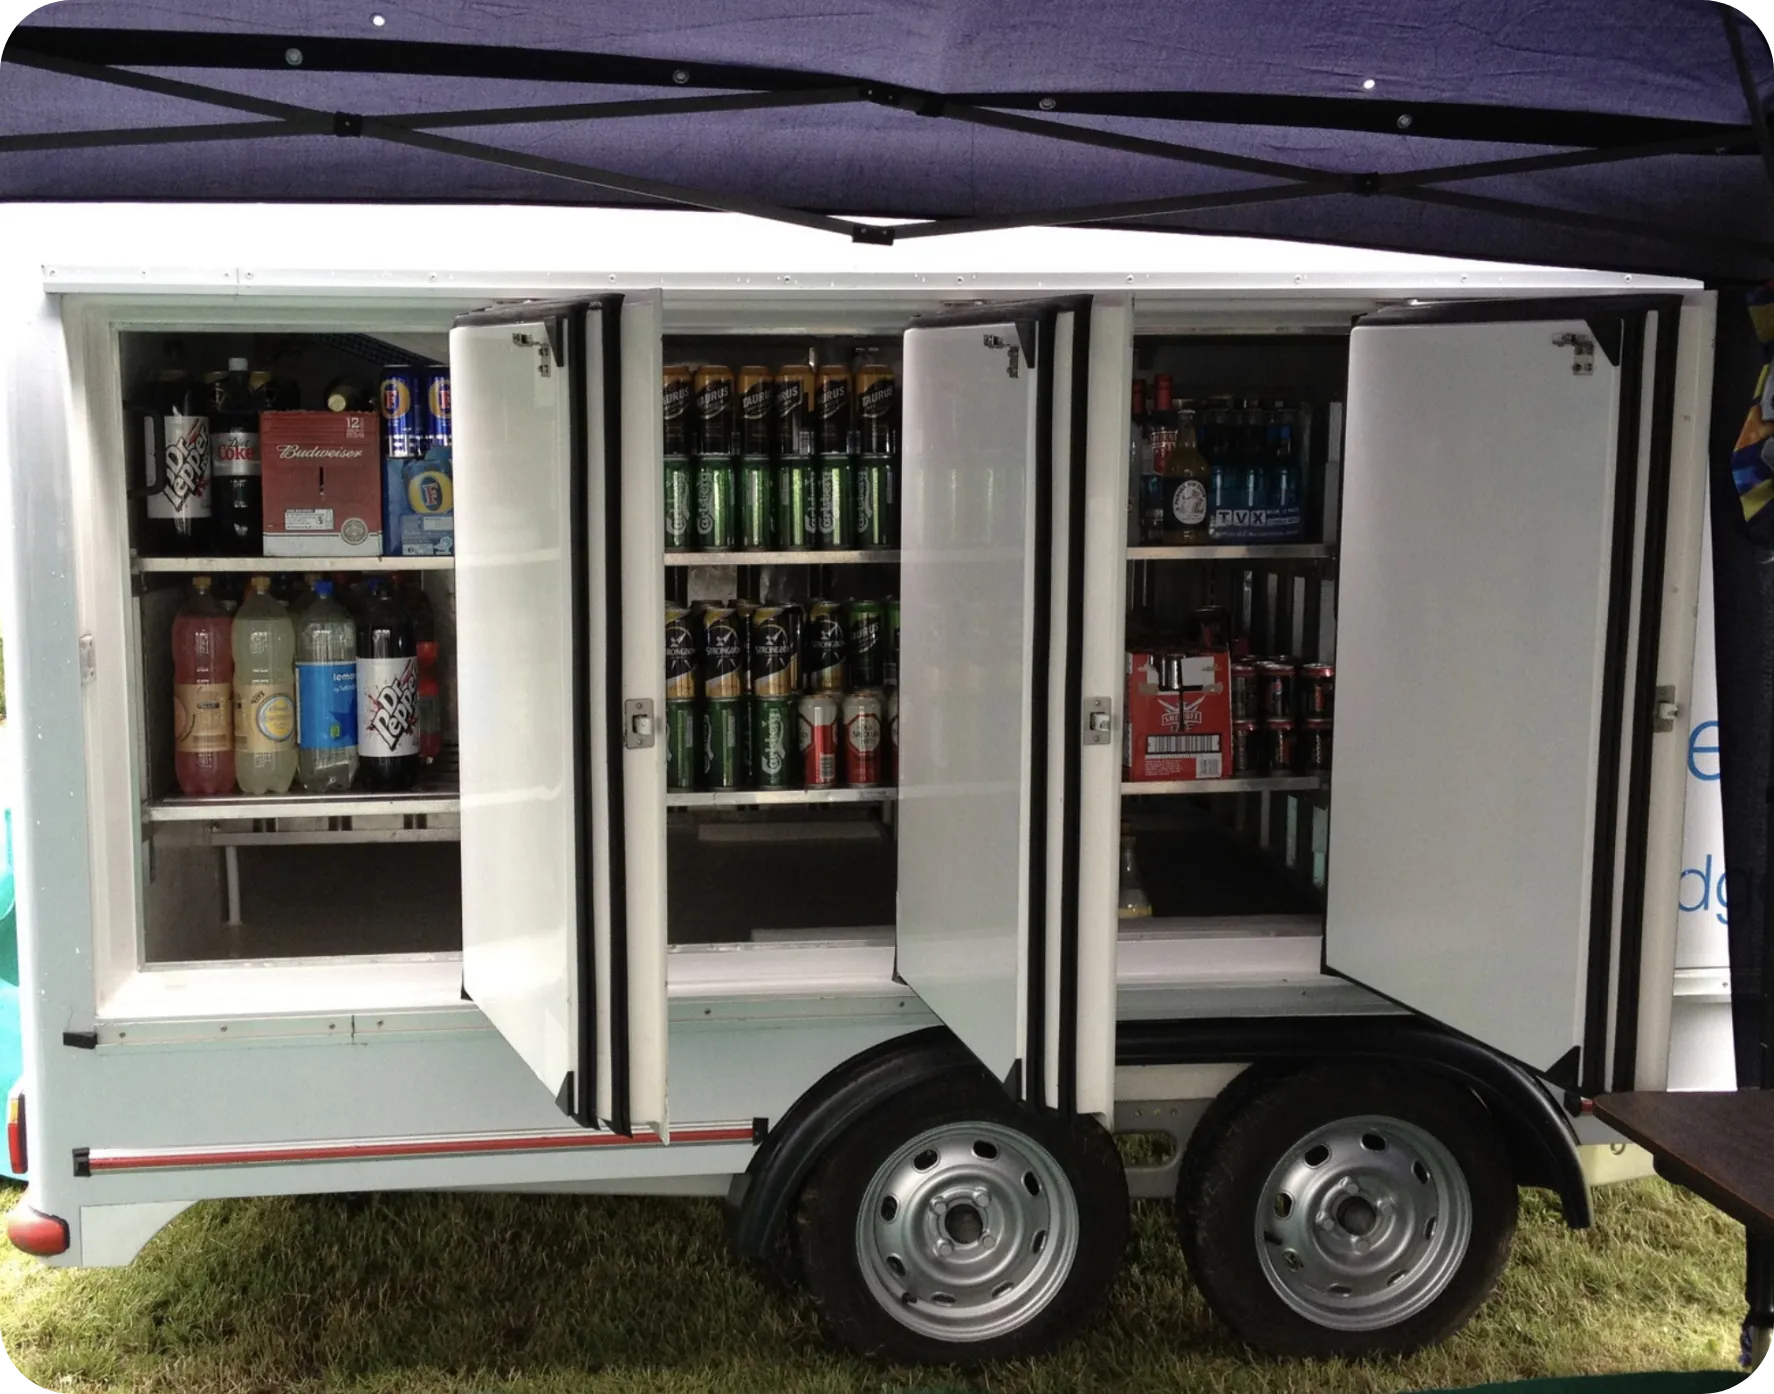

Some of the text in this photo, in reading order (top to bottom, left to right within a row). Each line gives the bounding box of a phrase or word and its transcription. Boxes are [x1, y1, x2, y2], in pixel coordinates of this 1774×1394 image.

[345, 416, 360, 428] 12
[165, 436, 189, 475] Dr
[276, 444, 363, 459] Budweiser
[1217, 510, 1264, 526] TVX
[377, 678, 403, 716] Dr
[762, 708, 783, 774] Carlsberg
